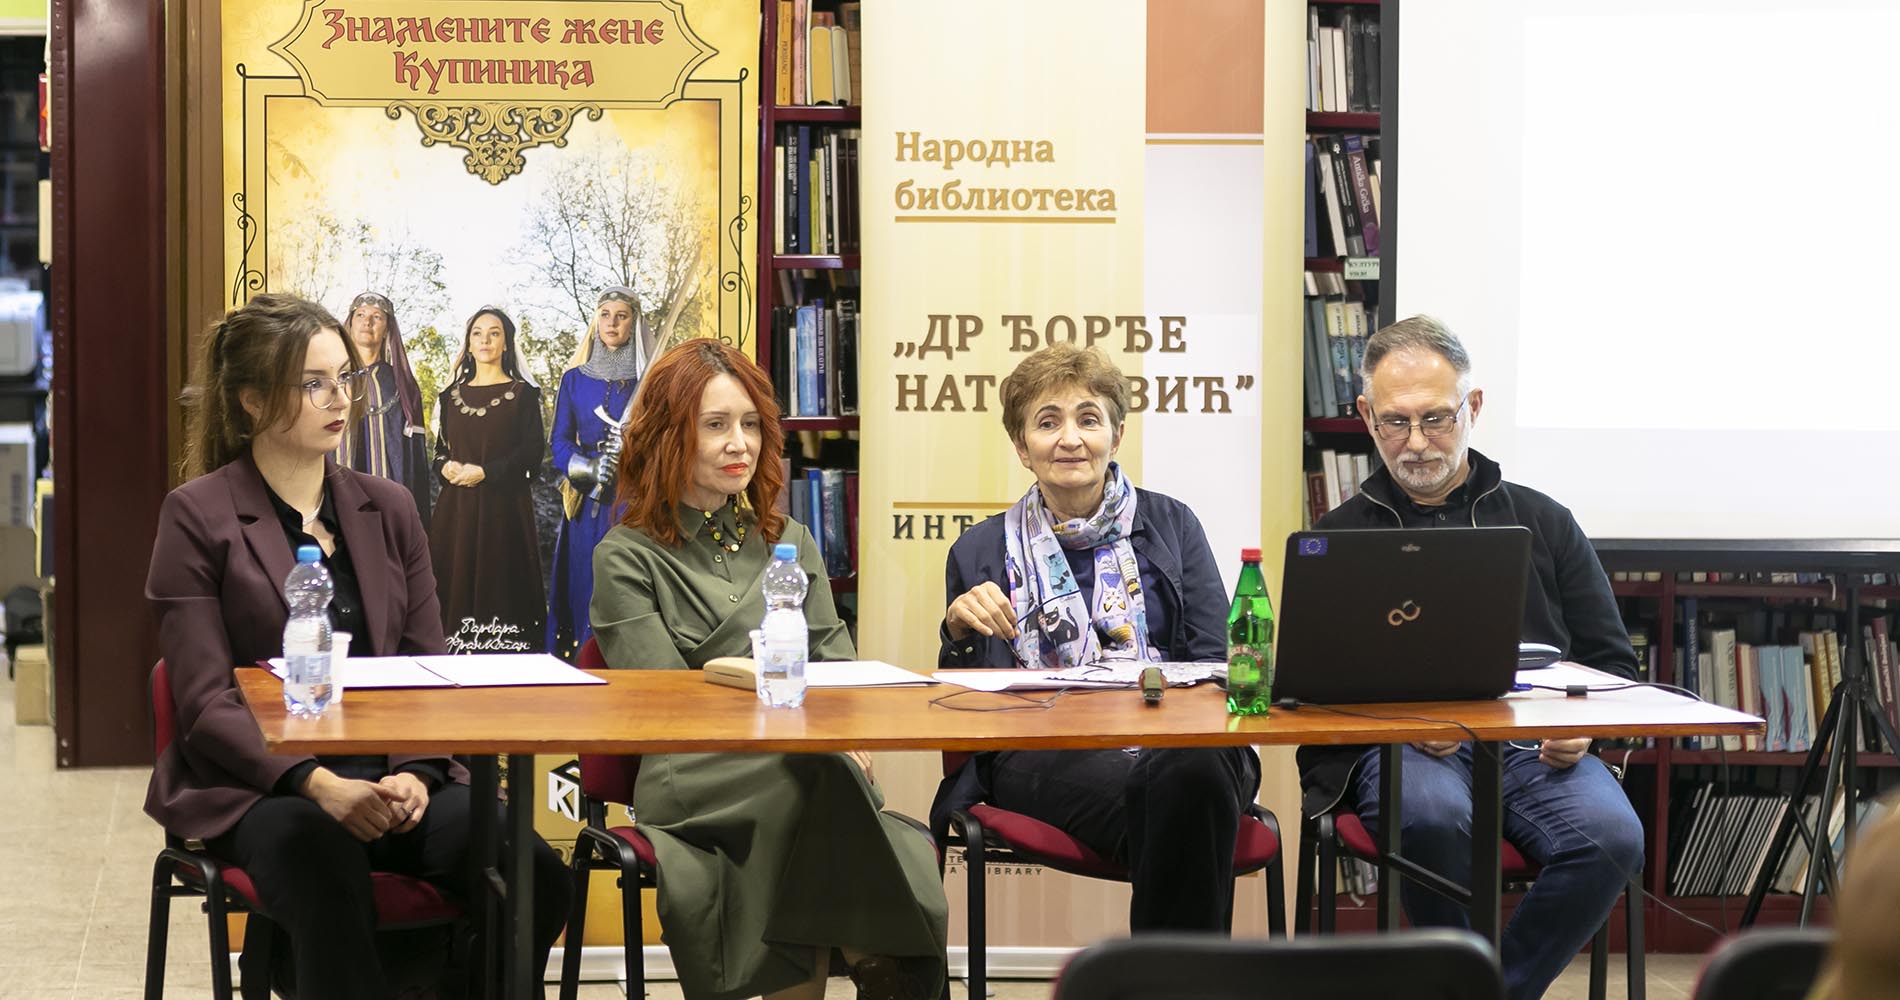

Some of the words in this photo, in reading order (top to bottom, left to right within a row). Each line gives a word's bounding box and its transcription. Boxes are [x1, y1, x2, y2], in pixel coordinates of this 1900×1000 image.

[895, 132, 1055, 170] Народна
[895, 179, 1117, 211] библиотека
[1001, 315, 1187, 353] ЂОРЂЕ
